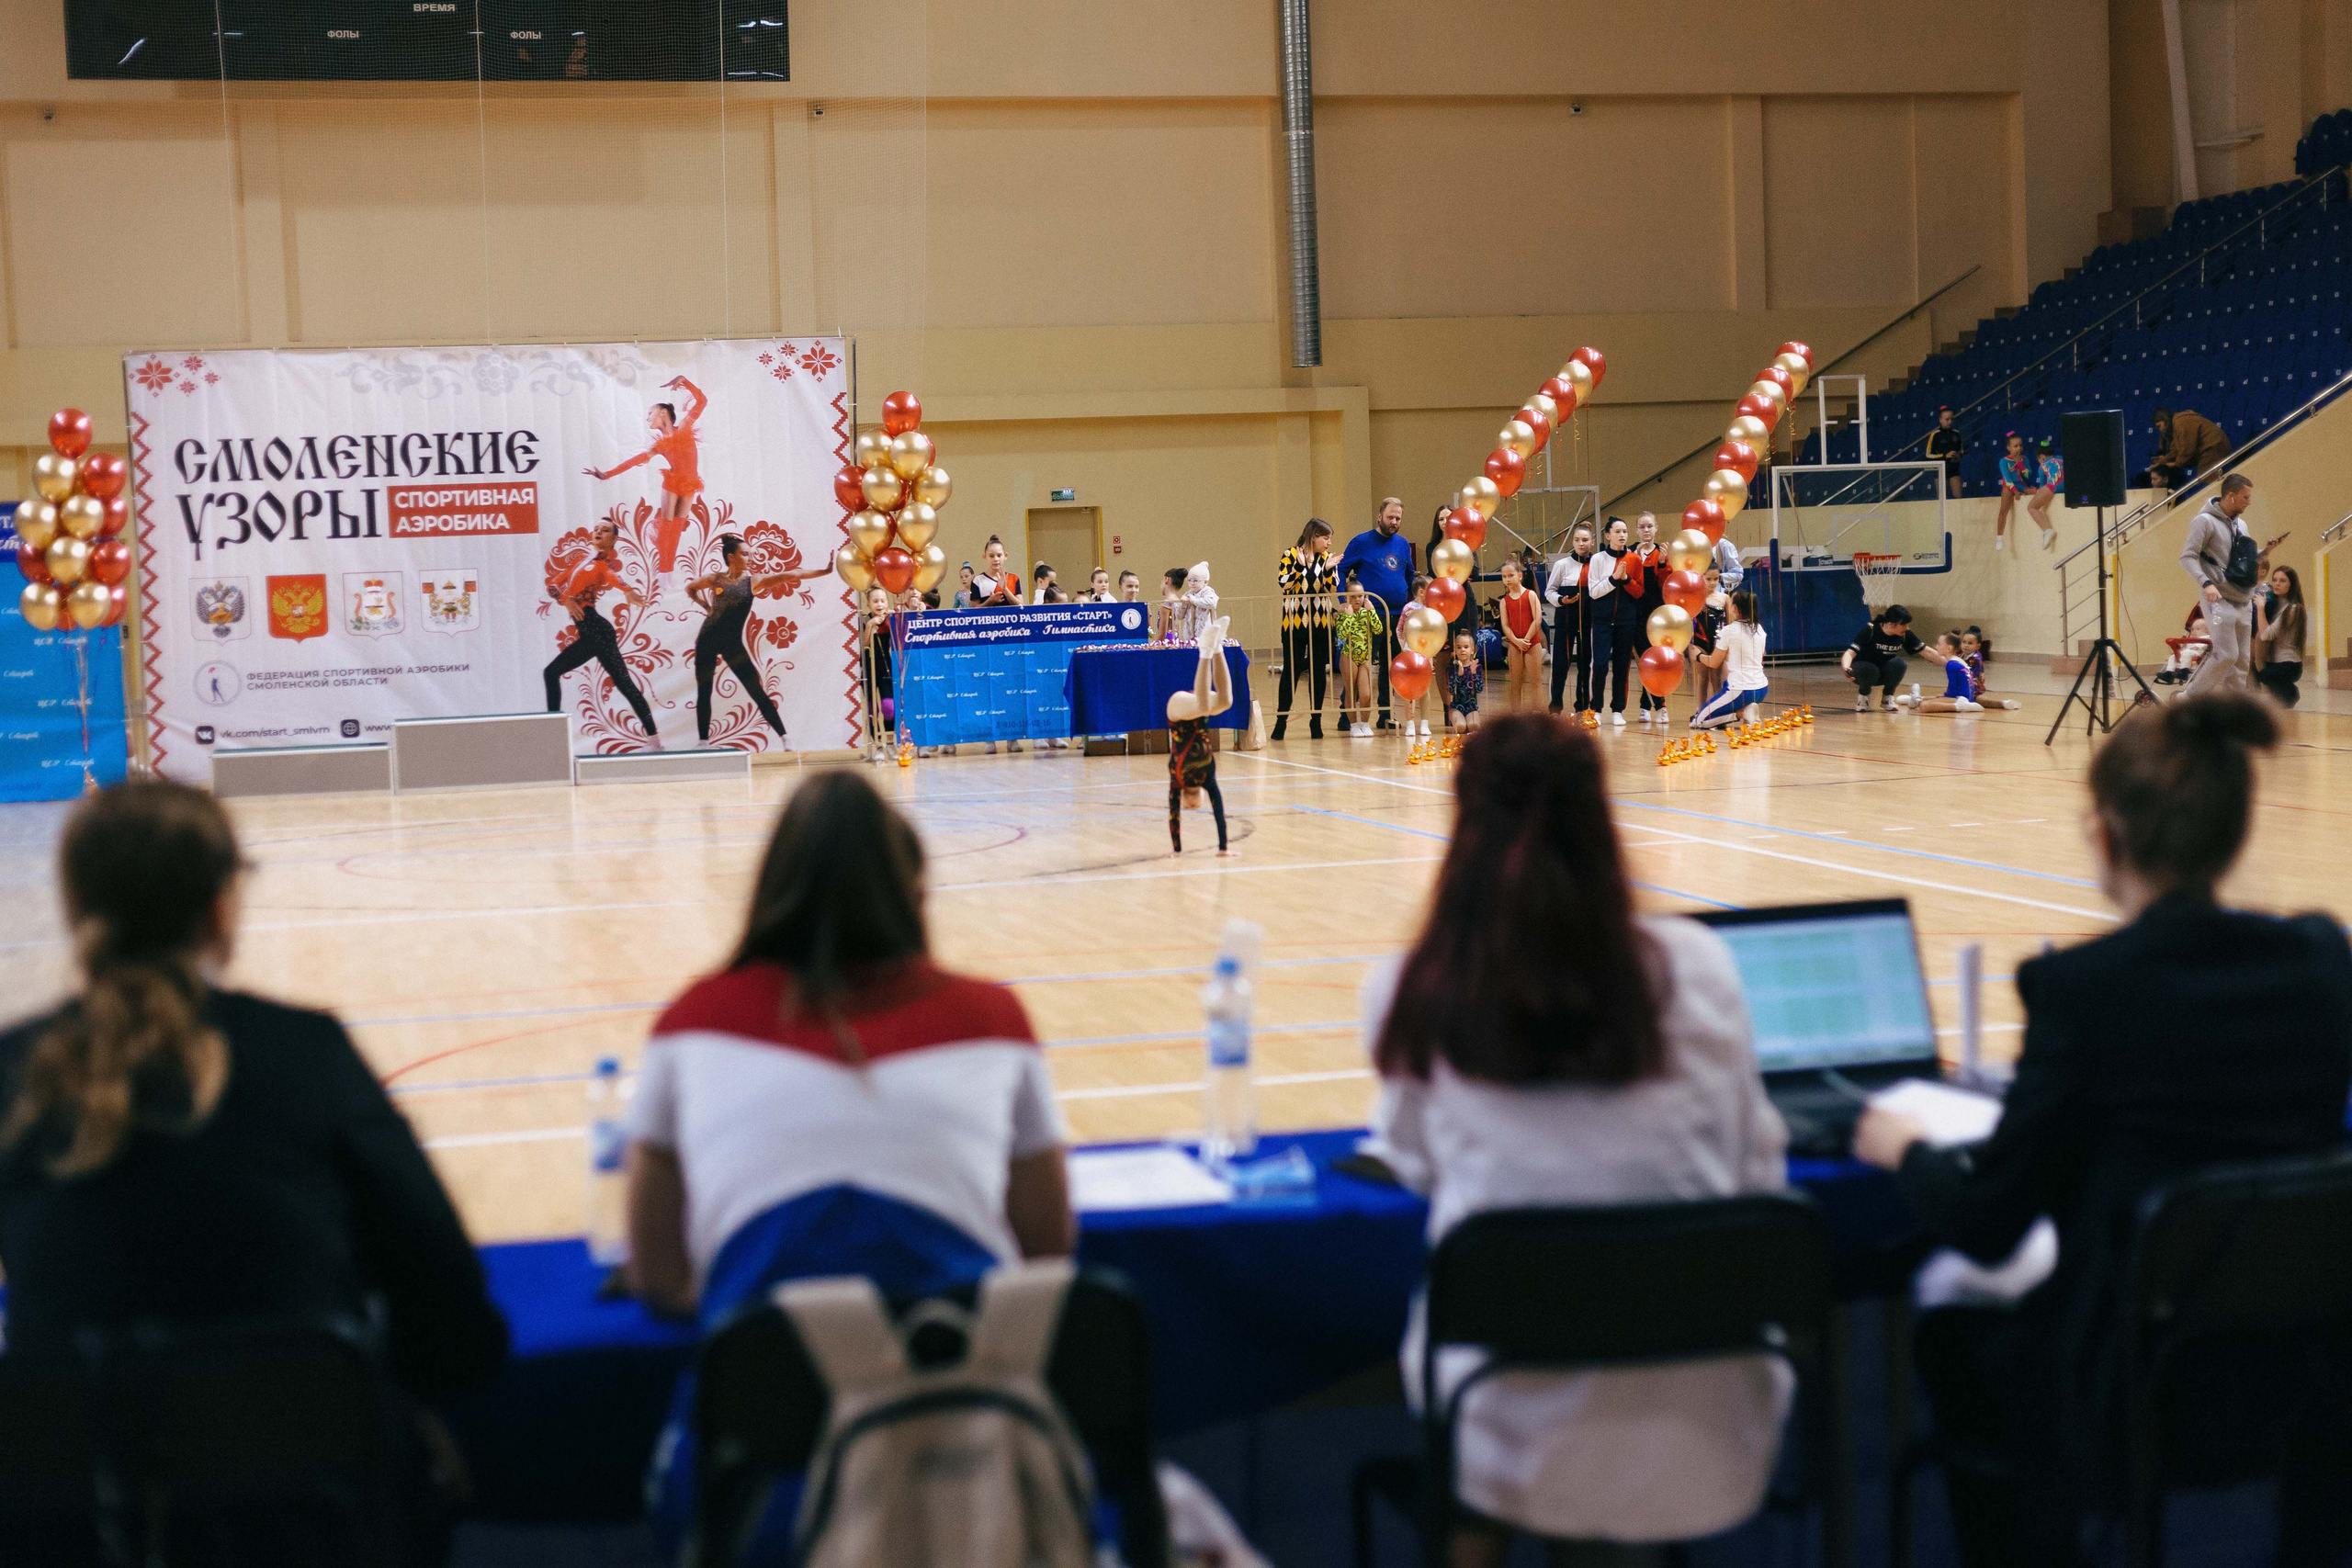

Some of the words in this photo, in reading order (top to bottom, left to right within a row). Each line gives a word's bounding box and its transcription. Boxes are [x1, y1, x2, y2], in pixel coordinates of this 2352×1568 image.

[413, 4, 456, 12] ВРЕМЯ
[327, 30, 359, 39] ФОЛЫ
[510, 31, 542, 39] ФОЛЫ
[174, 430, 540, 484] СМОЛЕНСКИЕ
[394, 488, 535, 510] СПОРТИВНАЯ
[175, 489, 382, 560] УЗОРЫ
[395, 513, 510, 533] АЭРОБИКА
[908, 619, 943, 630] ЦЕНТР
[944, 615, 1018, 627] СПОРТИВНОГО
[1020, 612, 1071, 623] РАЗВИТИЯ
[1072, 611, 1113, 620] «СТАРТ»
[905, 629, 977, 645] Спортивная
[978, 626, 1031, 641] аэробика
[1042, 624, 1116, 635] Гимнастика
[246, 670, 320, 682] ФЕДЕРАЦИЯ
[323, 666, 403, 678] СПОРТИВНОЙ
[407, 663, 470, 674] АЭРОБИКИ
[247, 679, 330, 691] СМОЛЕНСКОЙ
[334, 677, 389, 687] ОБЛАСТИ
